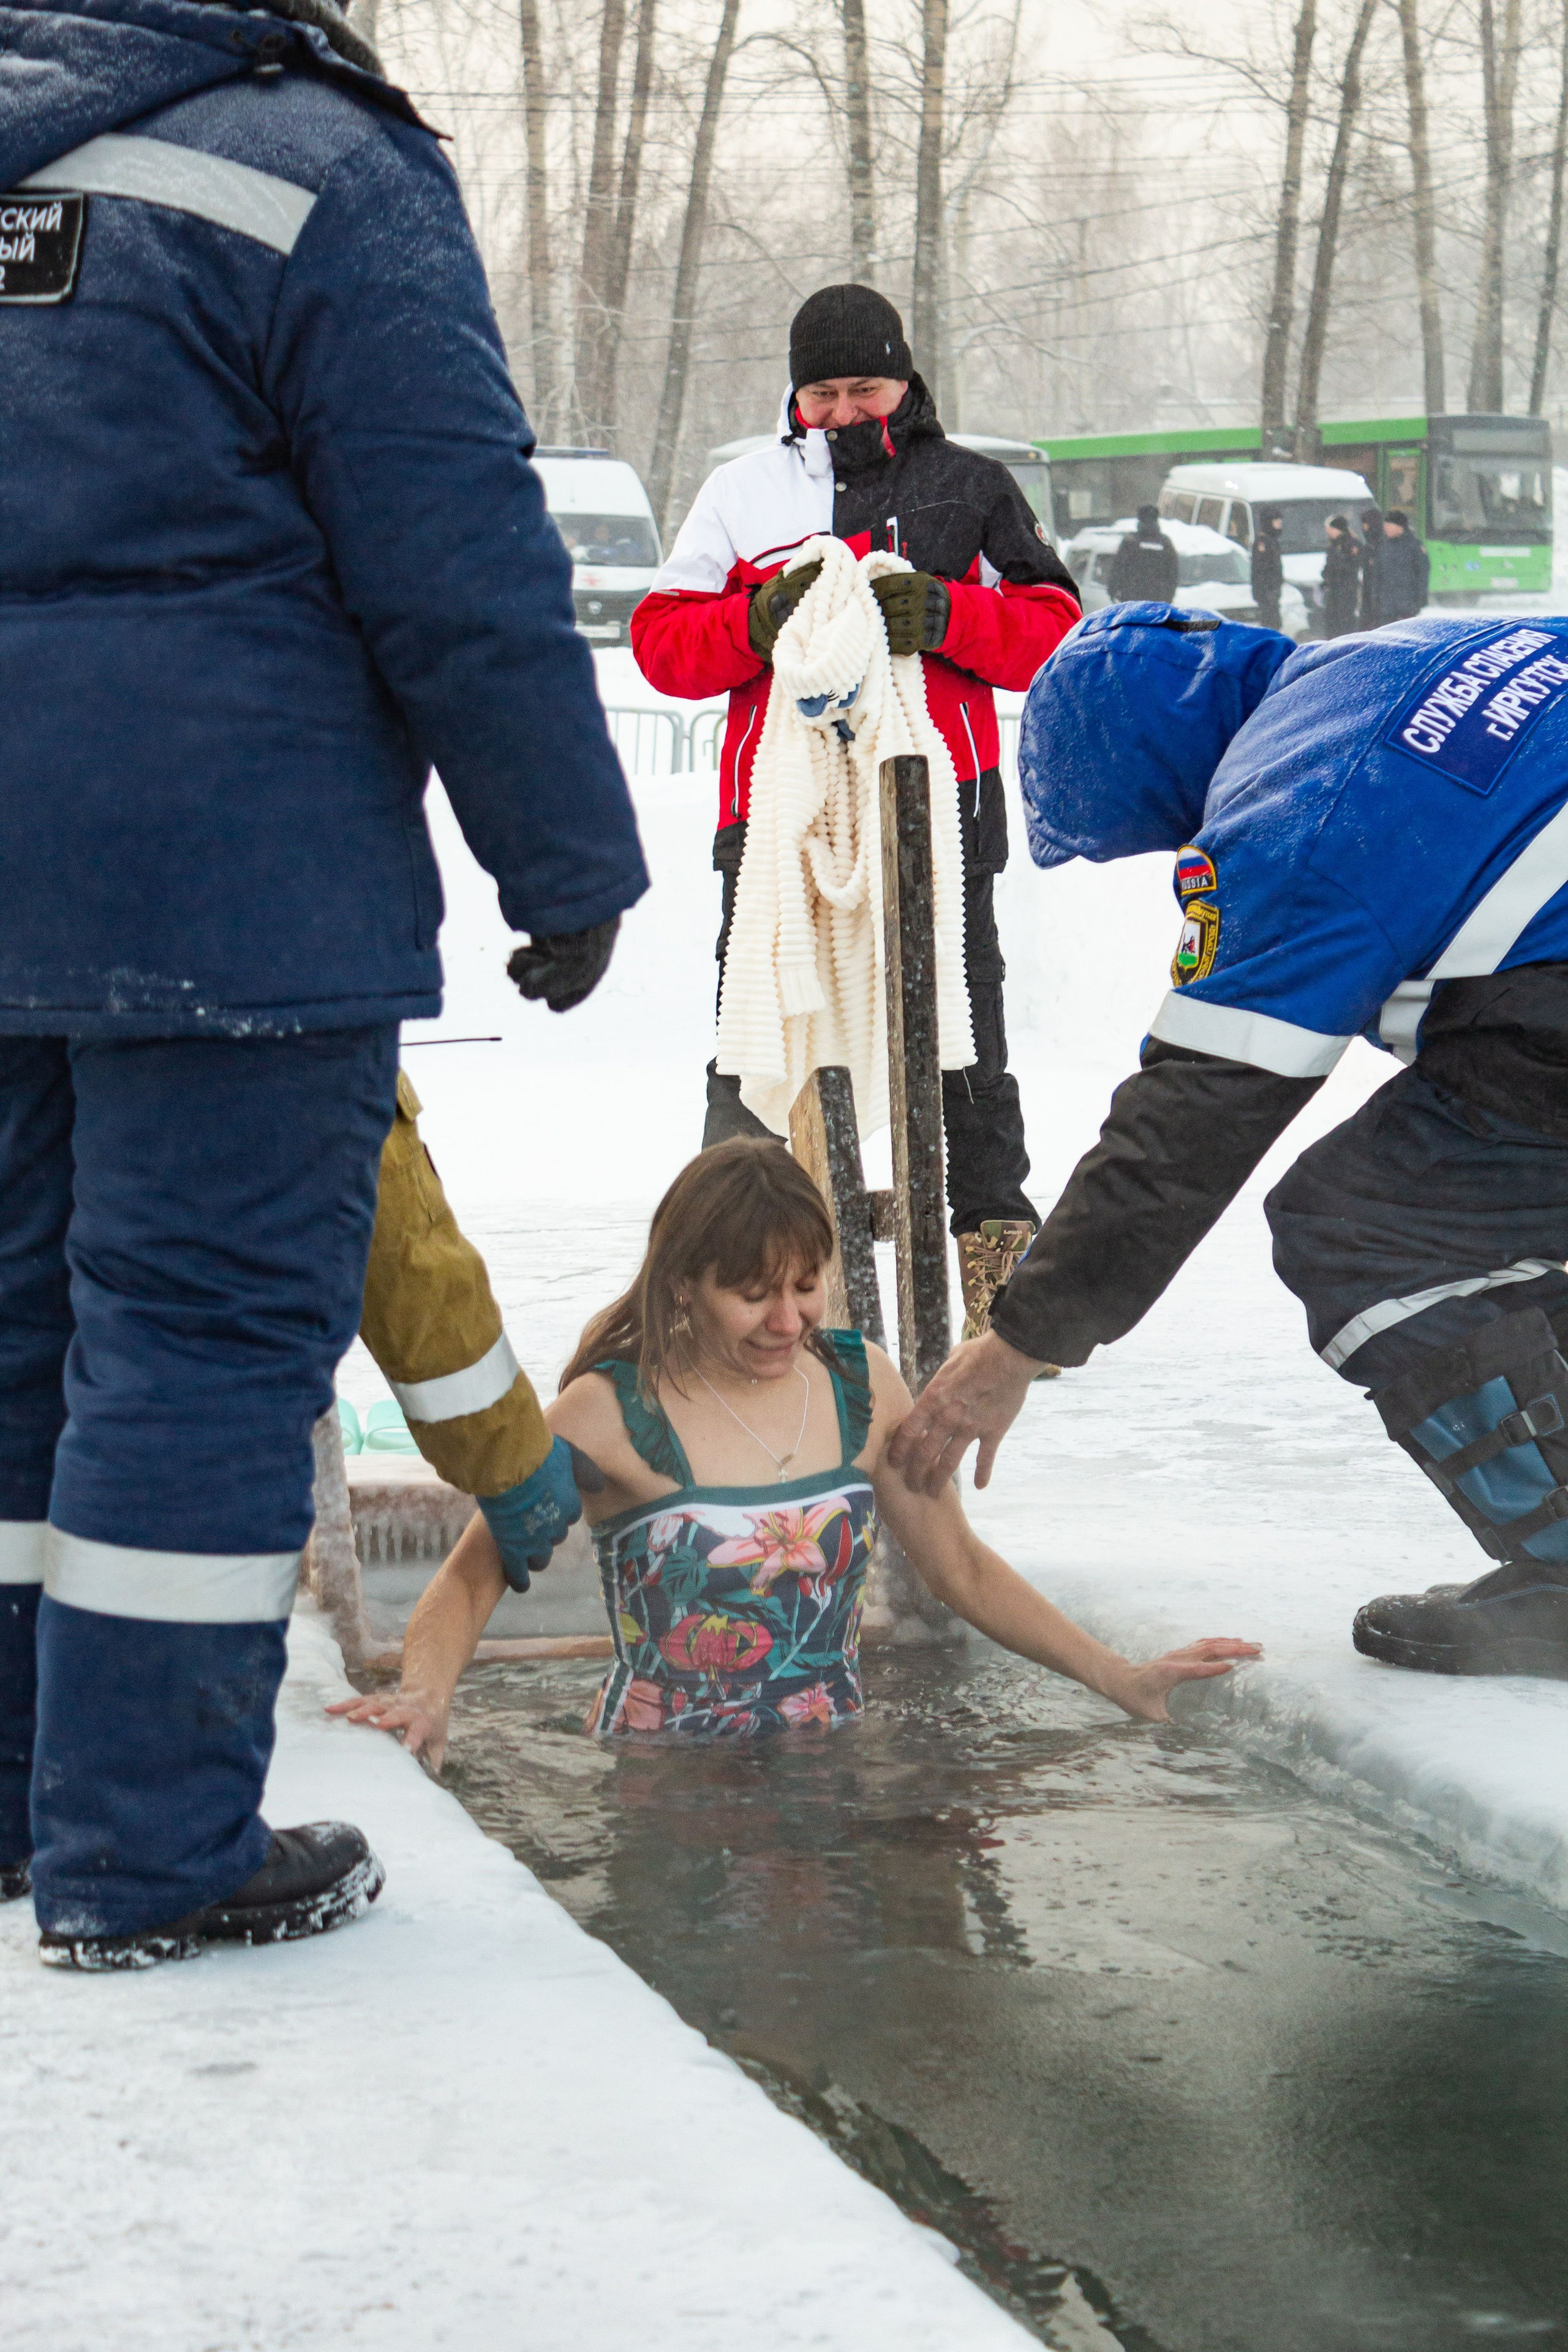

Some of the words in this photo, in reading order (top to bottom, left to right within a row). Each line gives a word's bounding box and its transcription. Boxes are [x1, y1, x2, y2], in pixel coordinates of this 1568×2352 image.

[0, 202, 62, 231] СКИЙ
[1403, 671, 1491, 753] СЛУЖБА
[1462, 628, 1558, 678] СПАСЕНИЯ
